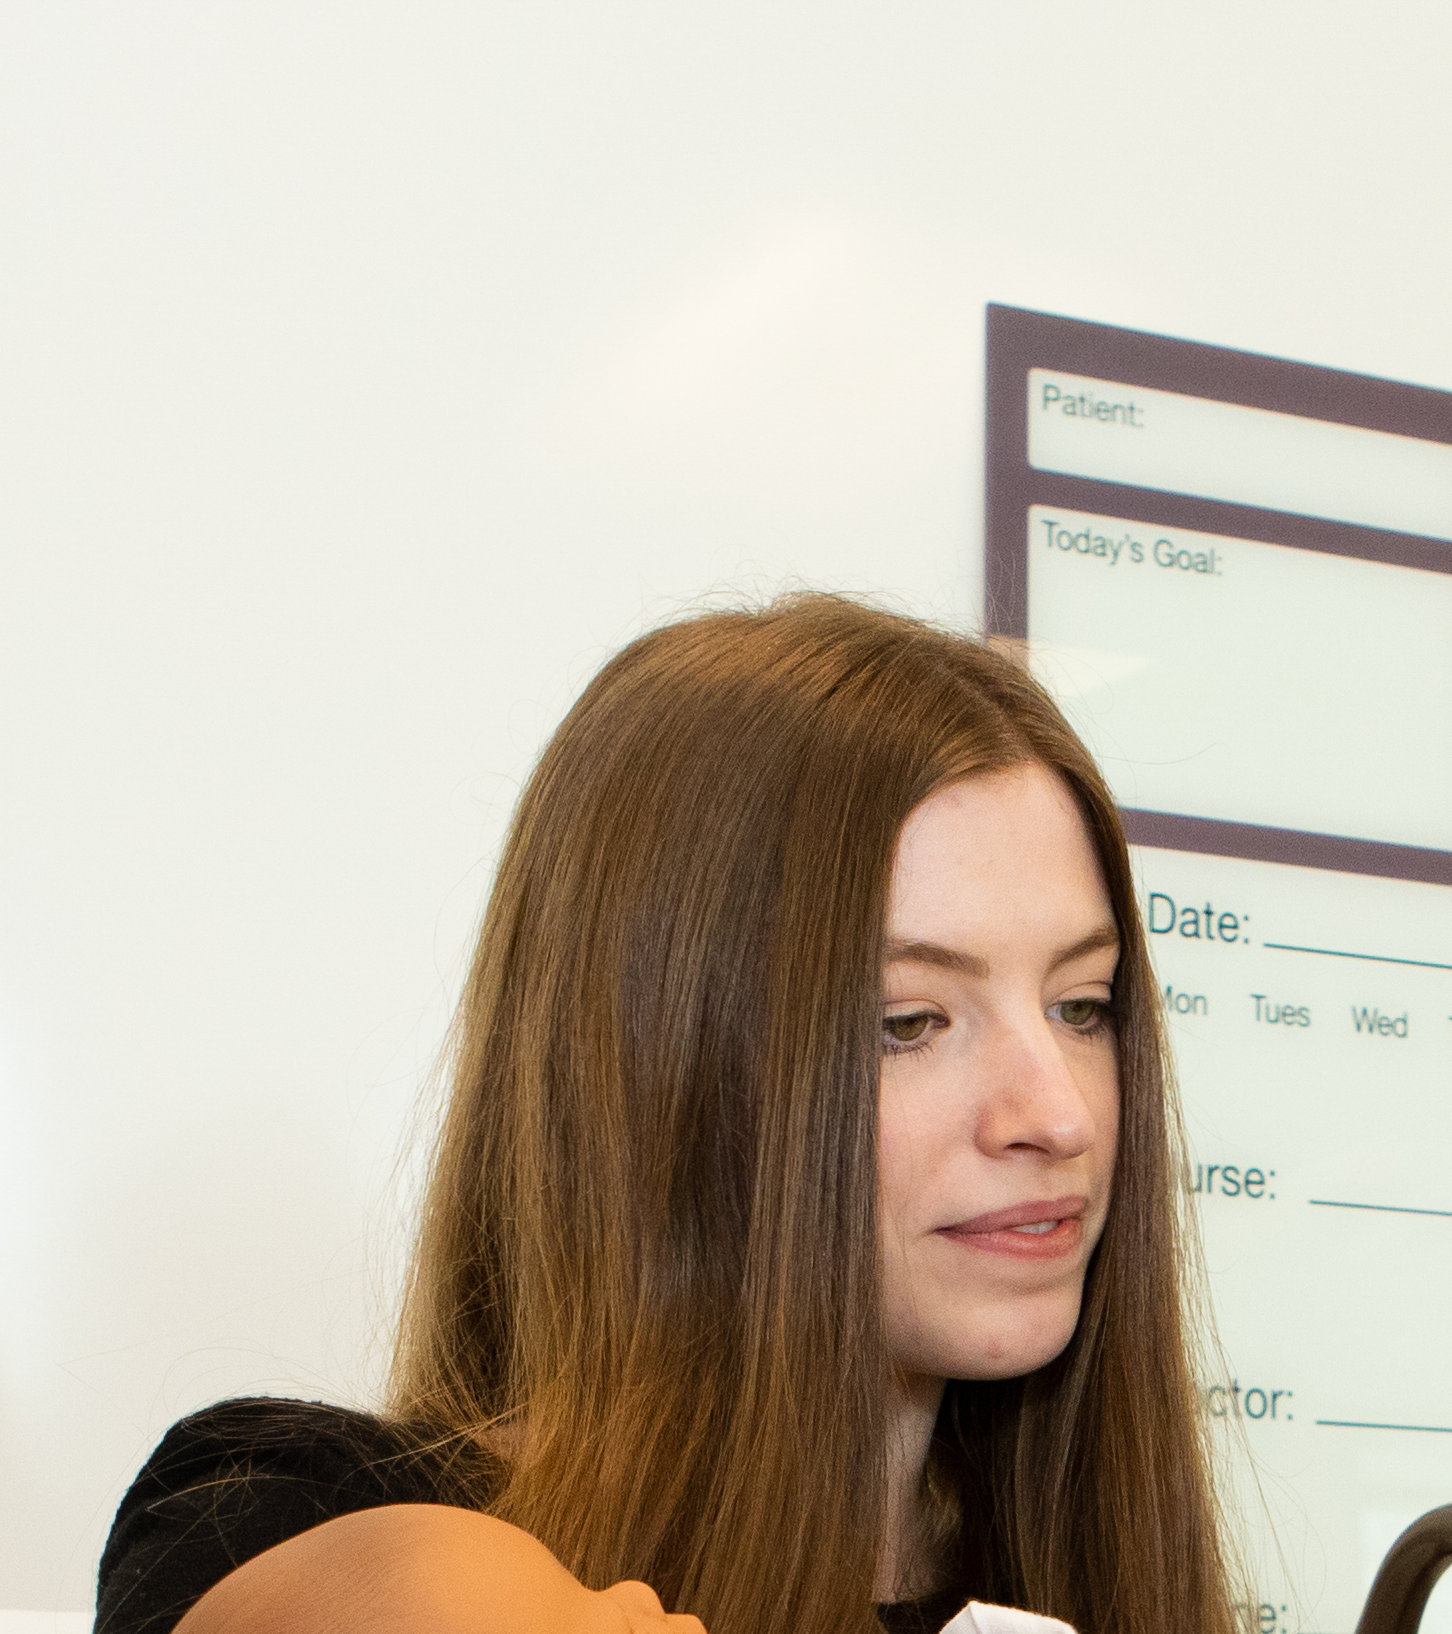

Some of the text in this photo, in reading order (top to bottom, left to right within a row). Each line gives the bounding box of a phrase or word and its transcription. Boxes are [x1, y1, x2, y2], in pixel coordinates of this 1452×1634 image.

[1042, 384, 1144, 428] Patient:
[1042, 519, 1223, 577] Today's Goal:
[1149, 892, 1250, 944] Date:
[1251, 993, 1311, 1028] Tues
[1352, 1005, 1409, 1038] Wed
